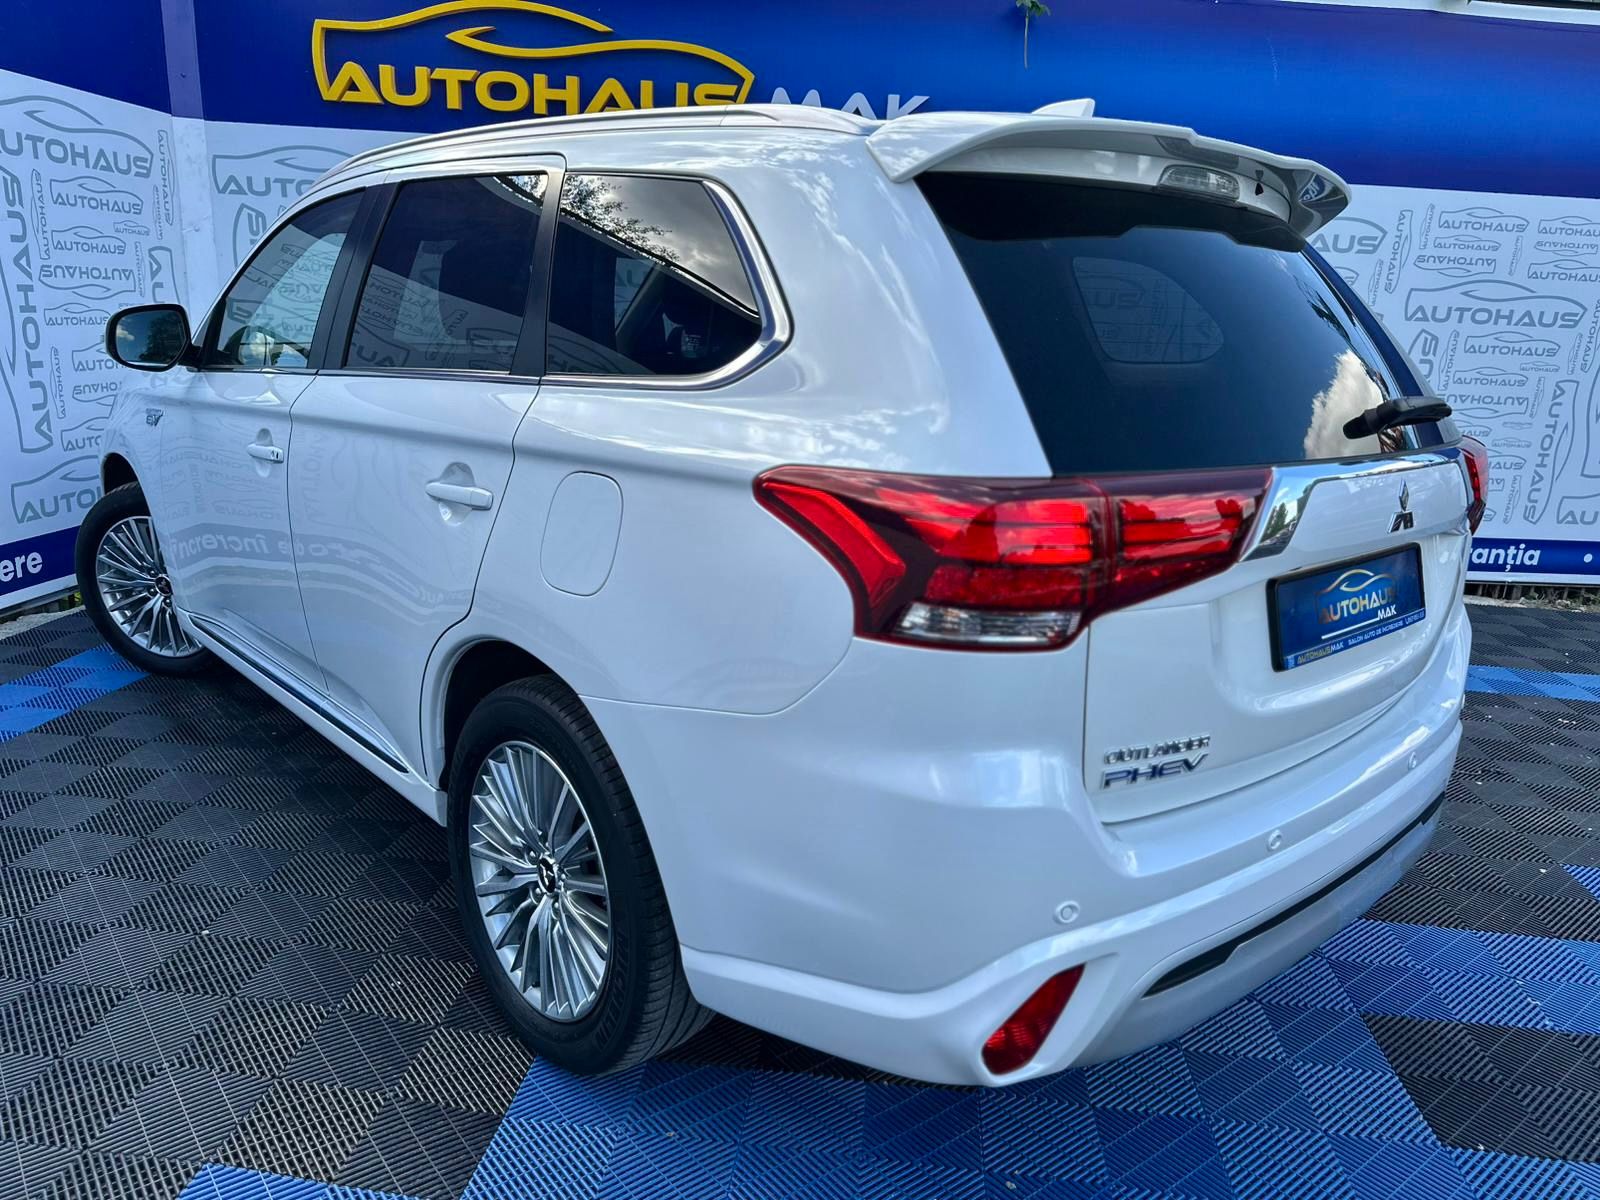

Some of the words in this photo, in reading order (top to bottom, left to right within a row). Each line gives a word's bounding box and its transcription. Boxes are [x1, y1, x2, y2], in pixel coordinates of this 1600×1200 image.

[323, 61, 740, 115] AUTOHAUS
[0, 128, 151, 178] UTOHAUS
[158, 133, 173, 224] AUTOHAUS
[35, 173, 50, 259] AUTOHAUS
[53, 192, 142, 215] AUTOHAUS
[1440, 219, 1526, 233] AUTOHAUS
[53, 240, 125, 255] AUTOHAUS
[1385, 211, 1406, 293] AUTOHAUS
[1435, 242, 1499, 252] AUTOHAUS
[40, 265, 132, 280] AUTOHAUS
[1417, 255, 1496, 267] AUTOHAUS
[1528, 271, 1600, 283] AUTOHAU
[1408, 305, 1580, 329] AUTOHAUS
[1466, 344, 1558, 357] AUTOHAUS
[1454, 377, 1526, 387] AUTOHAUS
[1523, 382, 1566, 524] AUTOHAUS
[19, 486, 100, 523] AUTO
[1470, 543, 1541, 572] anția
[1319, 587, 1397, 624] AUTOHAUS
[1377, 604, 1397, 620] MAK
[1104, 734, 1211, 764] OUTLANDER
[1102, 753, 1209, 789] PHEV
